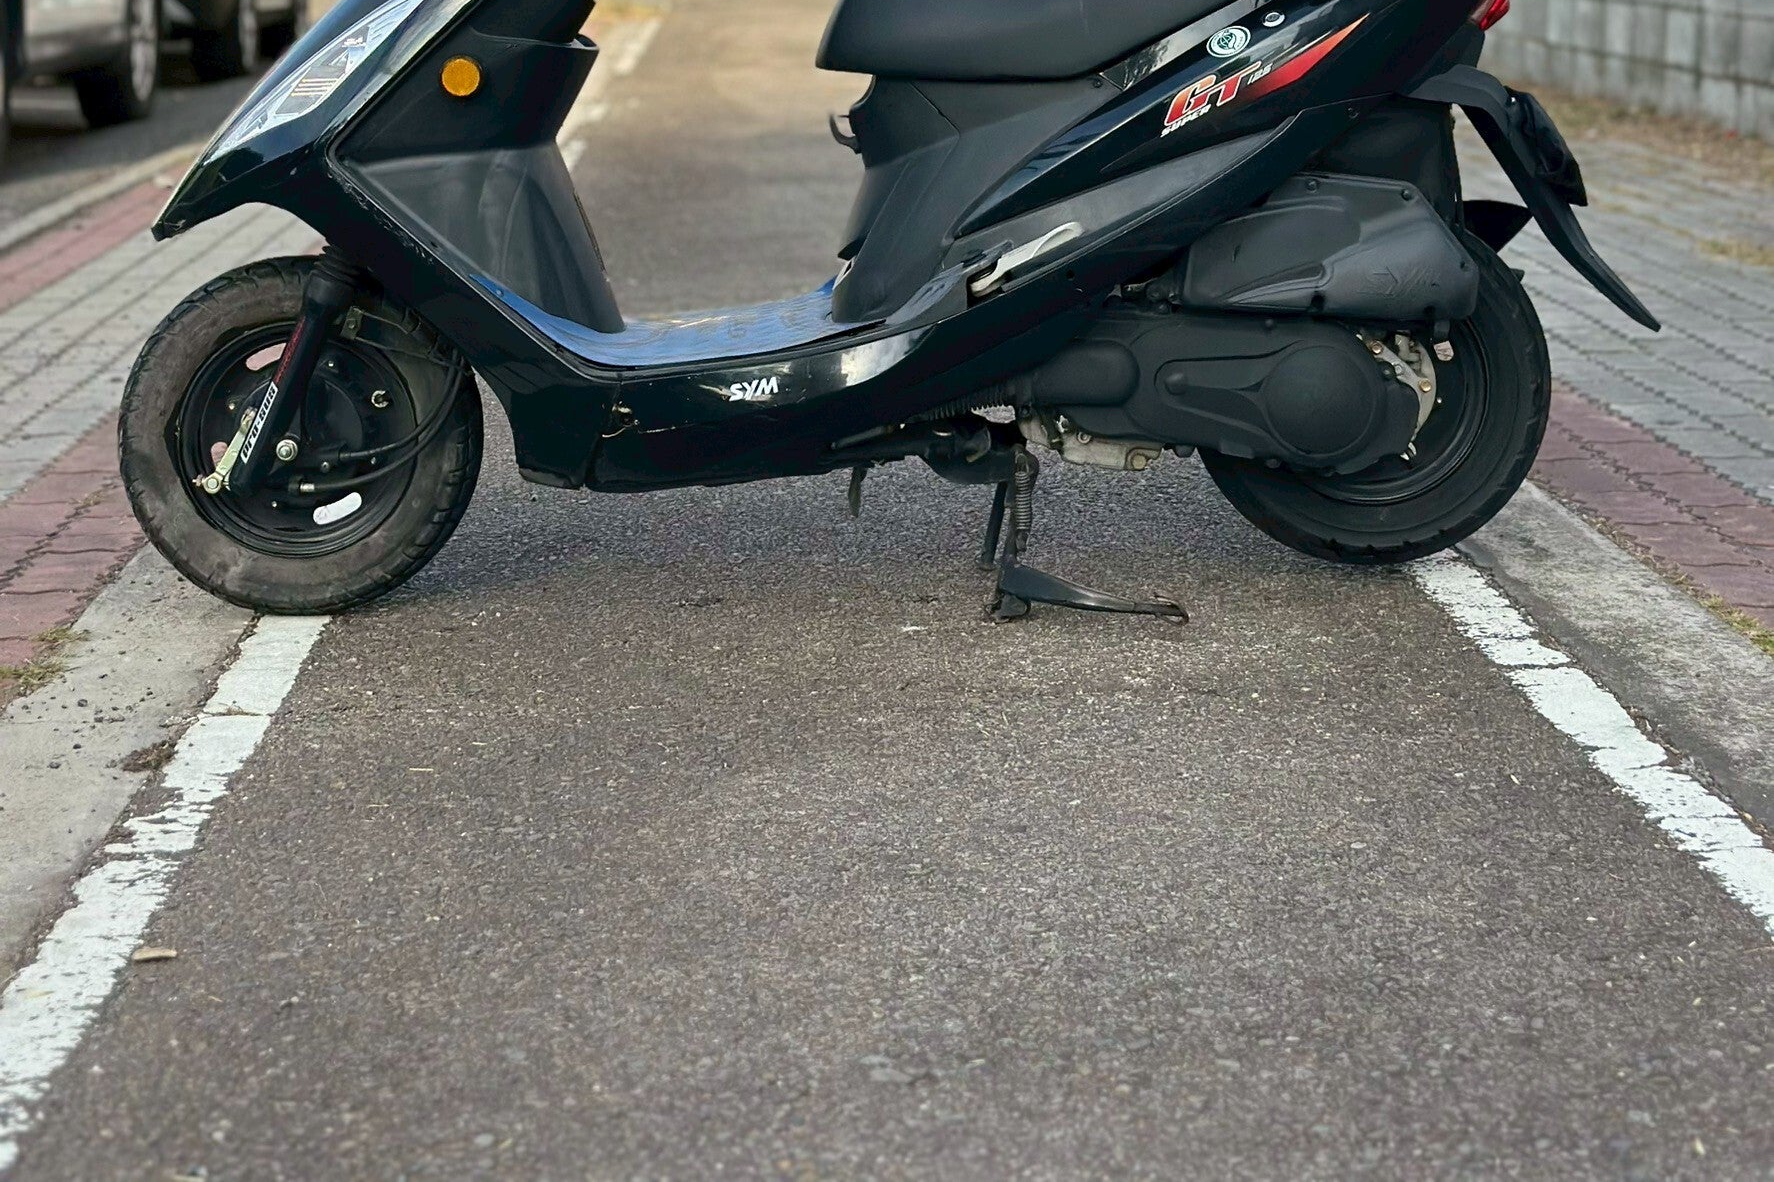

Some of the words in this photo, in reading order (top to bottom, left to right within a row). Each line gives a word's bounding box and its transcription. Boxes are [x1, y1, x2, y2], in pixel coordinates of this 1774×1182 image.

[1164, 60, 1262, 126] GT
[1160, 104, 1212, 138] SUPER
[728, 376, 779, 402] SYM
